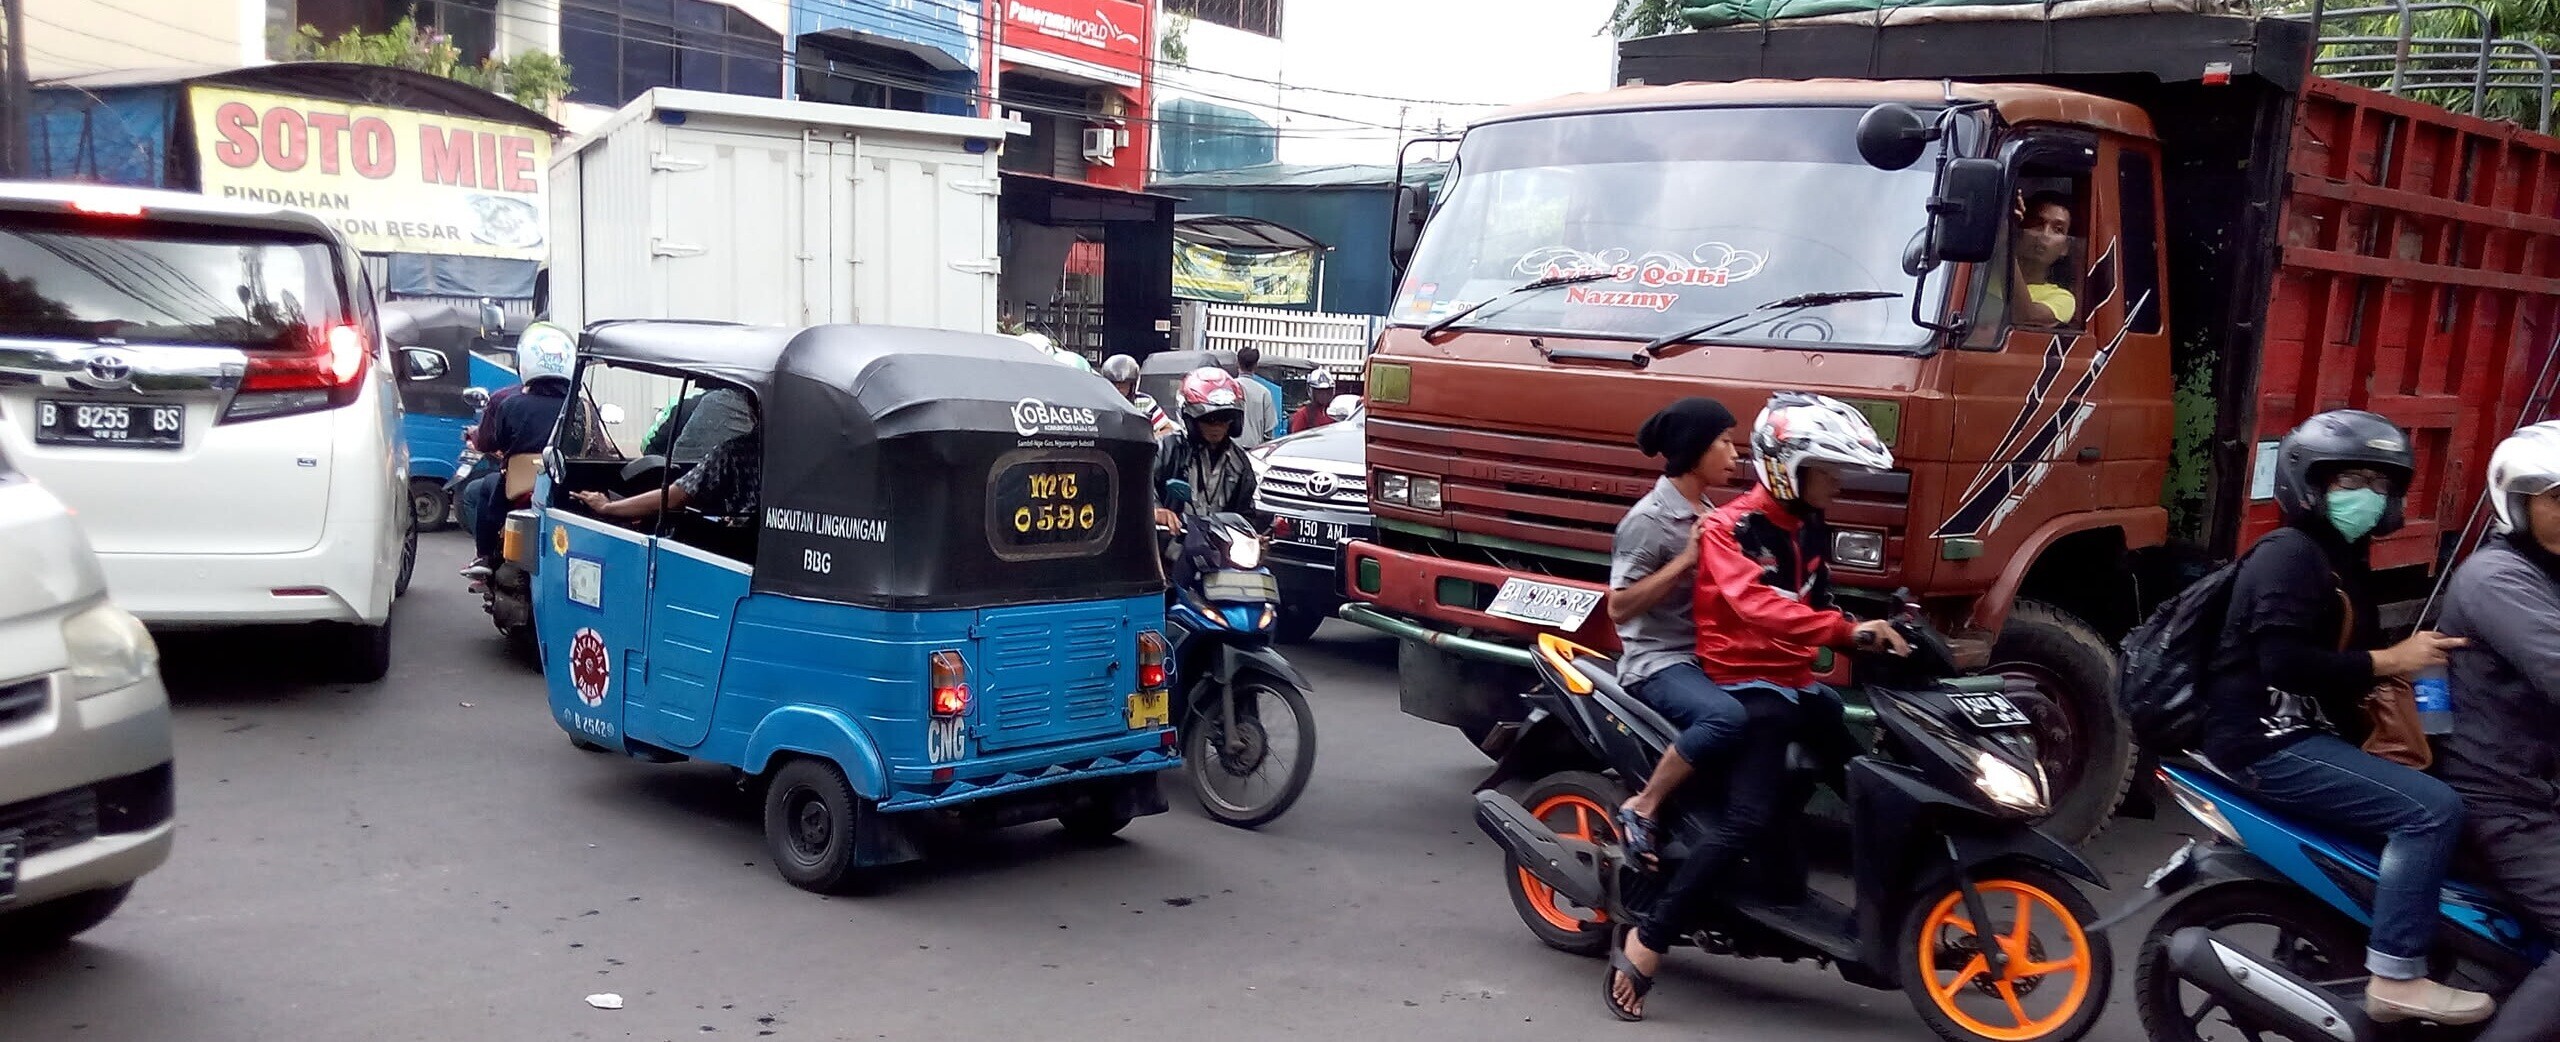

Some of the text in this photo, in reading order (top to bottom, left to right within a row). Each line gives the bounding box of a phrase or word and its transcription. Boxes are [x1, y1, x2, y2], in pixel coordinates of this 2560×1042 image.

[215, 101, 538, 193] SOTO MIE
[223, 185, 350, 210] PINDAHAN
[385, 220, 461, 241] BESAR
[1640, 264, 1730, 287] Qolbi
[1565, 286, 1678, 311] Nazzmy
[42, 404, 178, 431] B 8255 BS
[1010, 399, 1095, 430] KOBAGAS
[766, 507, 887, 542] ANGKUTAN LINGKUNGAN
[1299, 520, 1318, 537] 150
[1326, 524, 1343, 540] AM
[804, 549, 831, 574] BBG
[1500, 583, 1523, 601] BA
[928, 719, 965, 764] CNG
